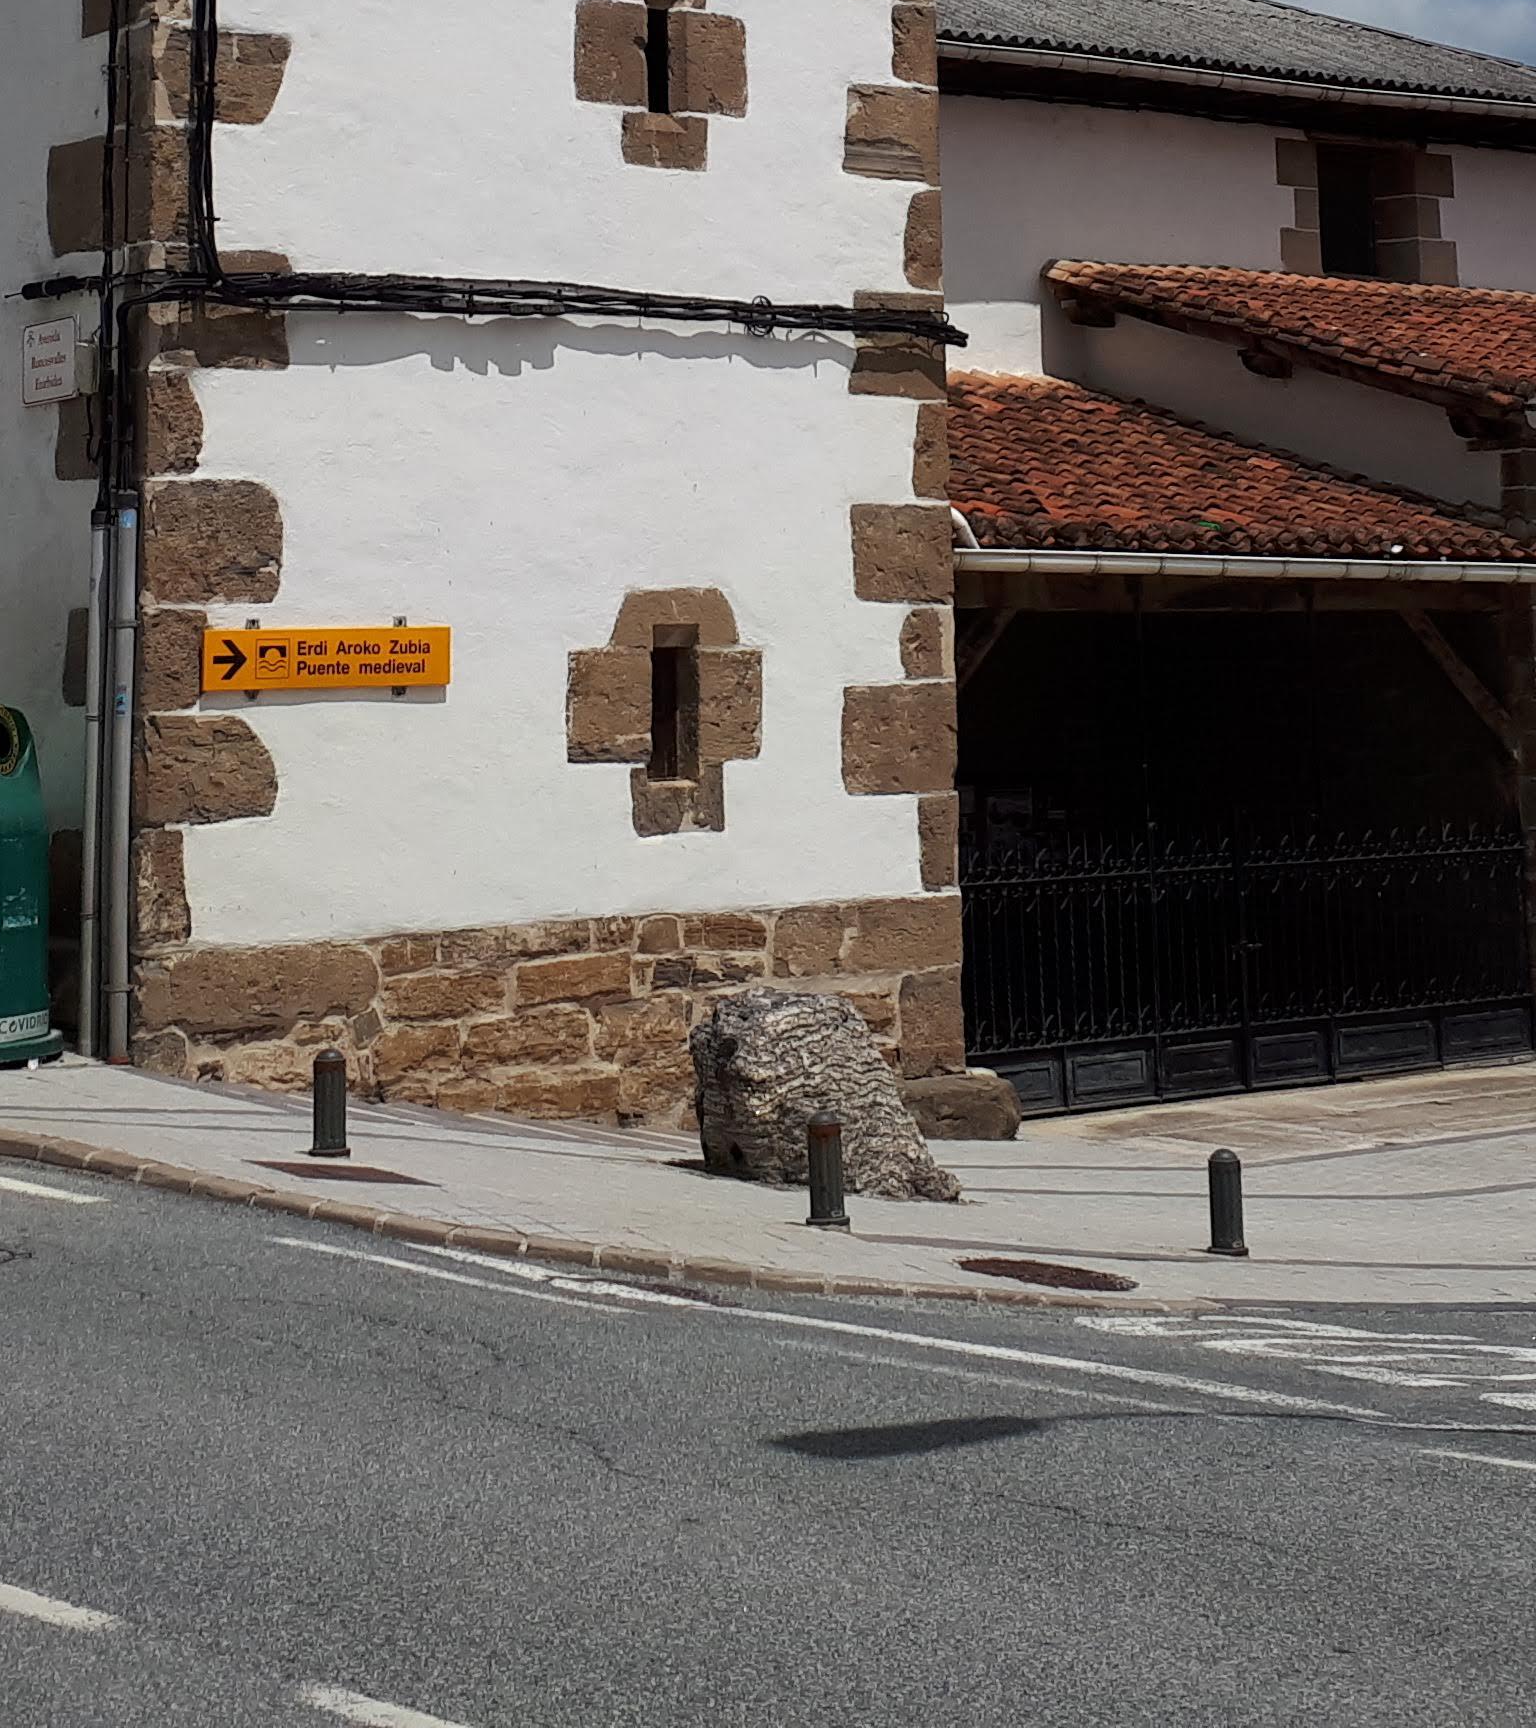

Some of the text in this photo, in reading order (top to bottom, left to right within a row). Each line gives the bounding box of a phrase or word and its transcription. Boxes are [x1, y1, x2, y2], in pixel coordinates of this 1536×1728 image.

[297, 639, 430, 656] Erdi Aroko Zubia
[297, 658, 426, 675] Puente medieval
